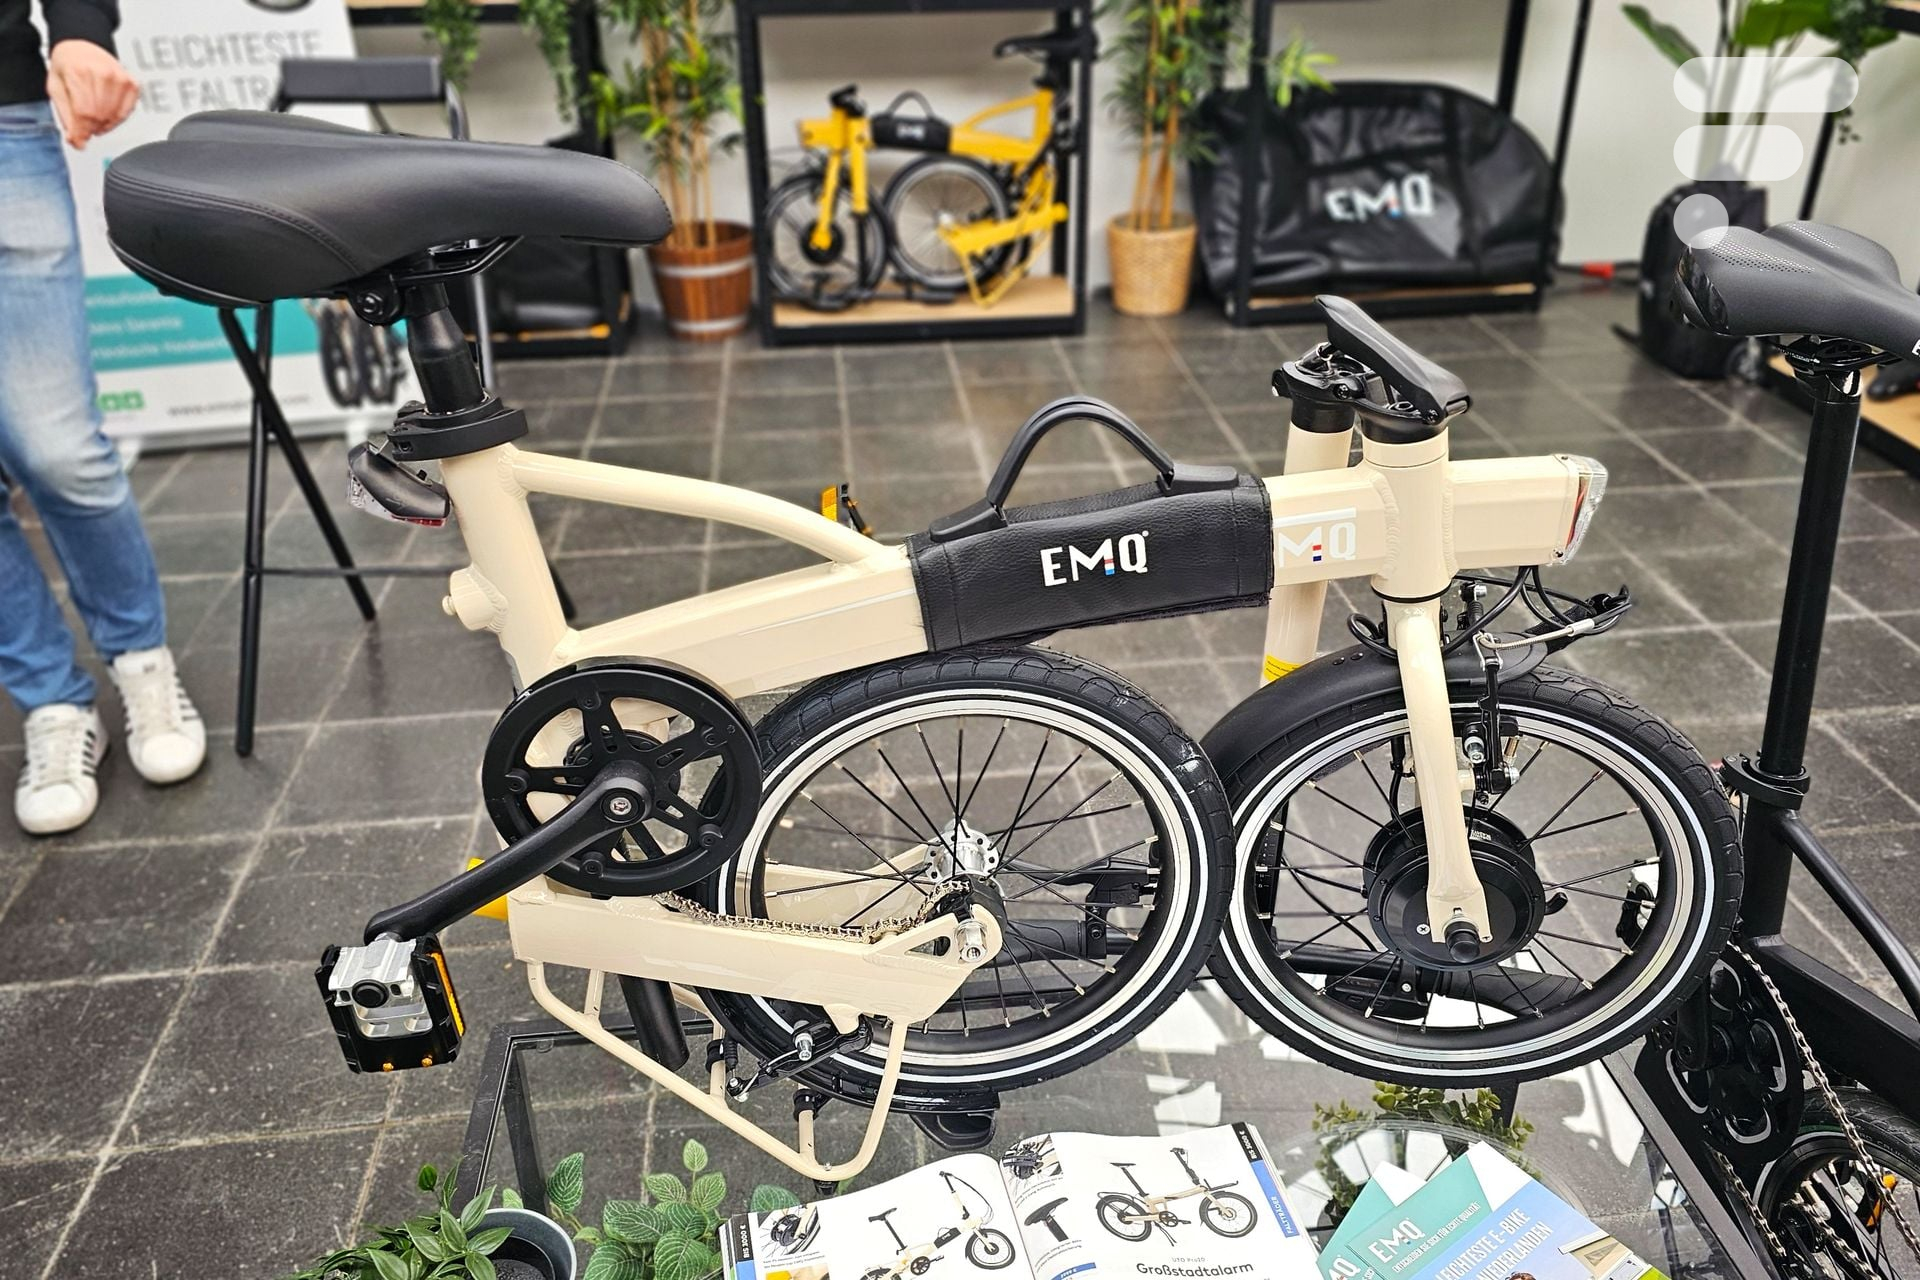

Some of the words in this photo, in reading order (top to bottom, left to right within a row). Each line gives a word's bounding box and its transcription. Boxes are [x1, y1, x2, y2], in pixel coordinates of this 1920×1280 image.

[133, 30, 319, 71] LEICHTESTE
[1040, 530, 1149, 587] EMQ
[1277, 522, 1356, 567] MQ
[1368, 1217, 1426, 1264] EMQ
[1487, 1207, 1531, 1245] E-BIKE
[1136, 1263, 1254, 1277] Großstadtalarm
